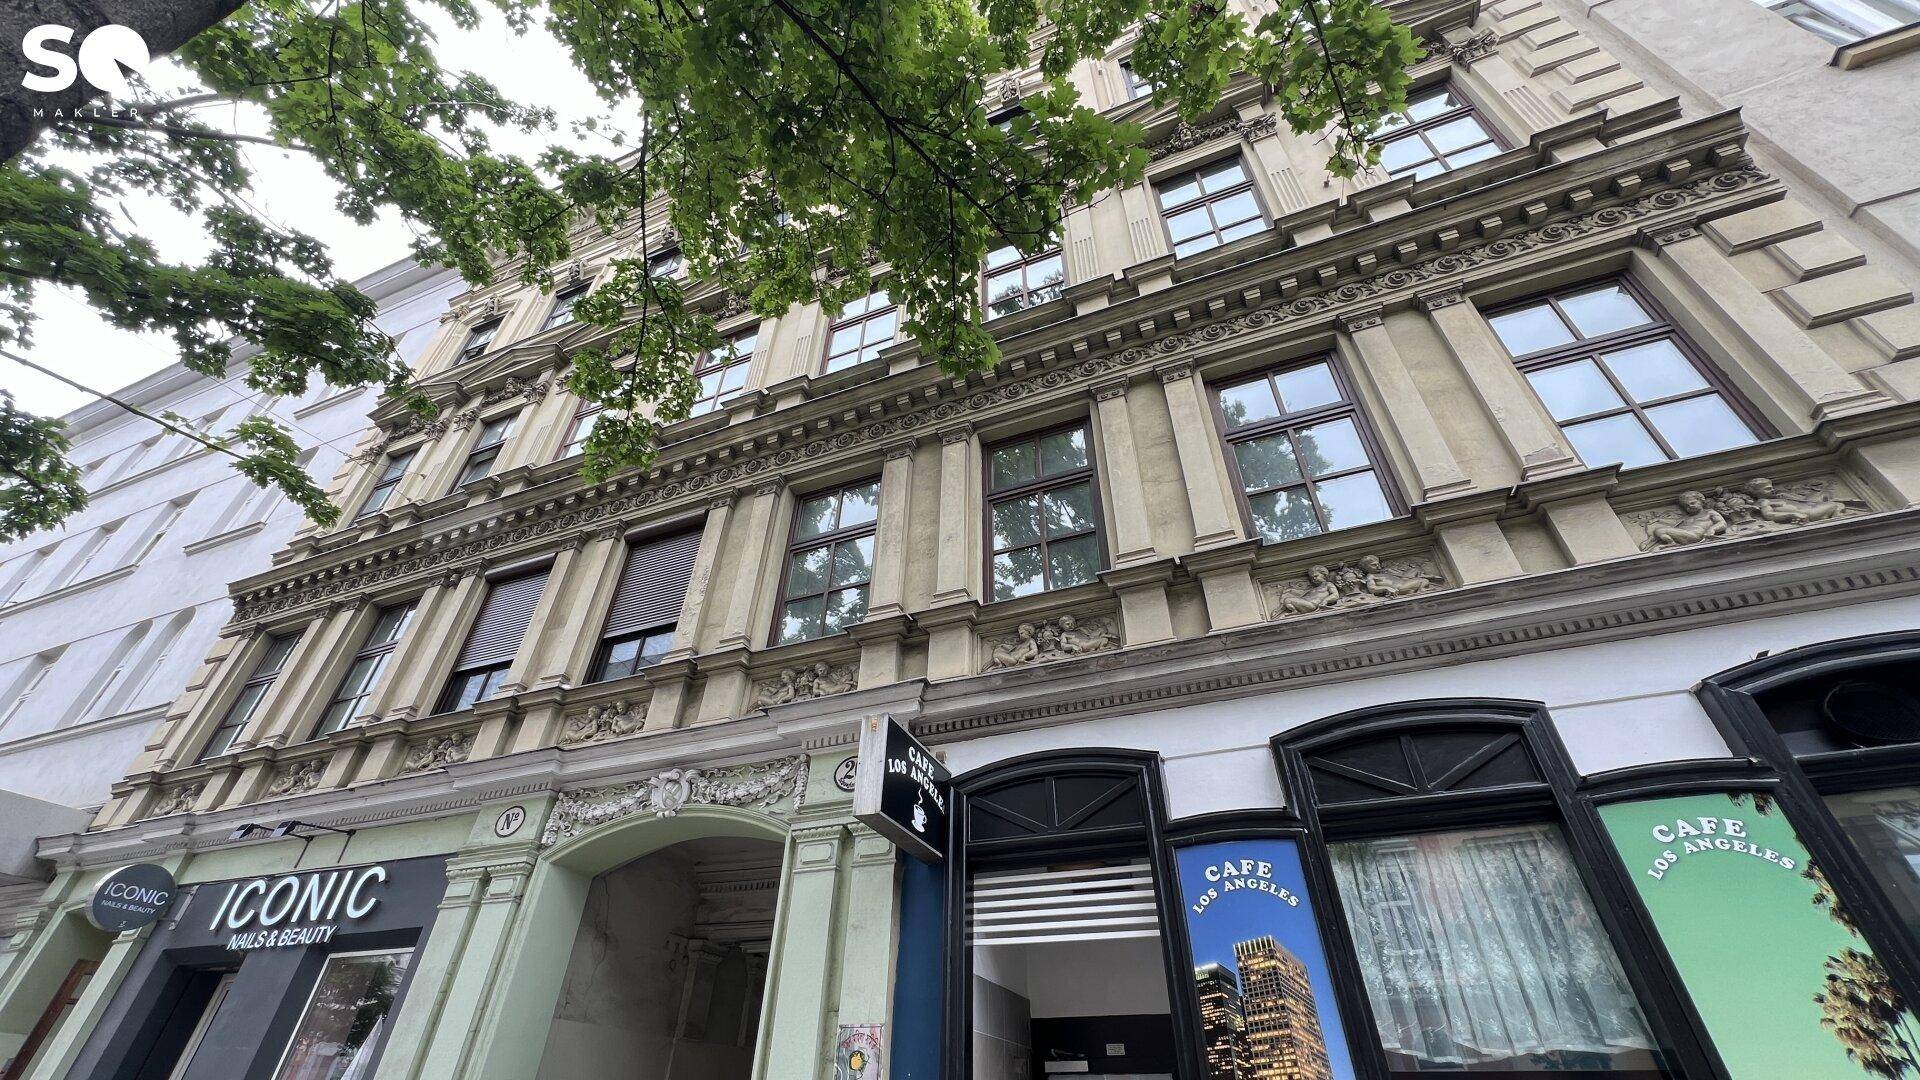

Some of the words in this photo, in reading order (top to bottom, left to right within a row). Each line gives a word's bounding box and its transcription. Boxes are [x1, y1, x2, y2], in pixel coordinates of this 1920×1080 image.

[888, 758, 907, 775] LOS
[908, 746, 935, 780] CAFE
[1652, 816, 1747, 843] CAFE
[1204, 859, 1273, 882] CAFE
[1647, 849, 1678, 880] LOS
[1683, 837, 1796, 870] ANGELES
[104, 881, 169, 906] ICONIC
[209, 866, 386, 931] ICONIC
[1192, 887, 1218, 915] LOS
[1223, 877, 1300, 908] ANGELES
[101, 900, 121, 909] NAILS
[128, 904, 156, 914] BEAUTY
[227, 930, 265, 950] NAILS
[265, 930, 279, 947] &
[278, 925, 339, 947] BEAUTY
